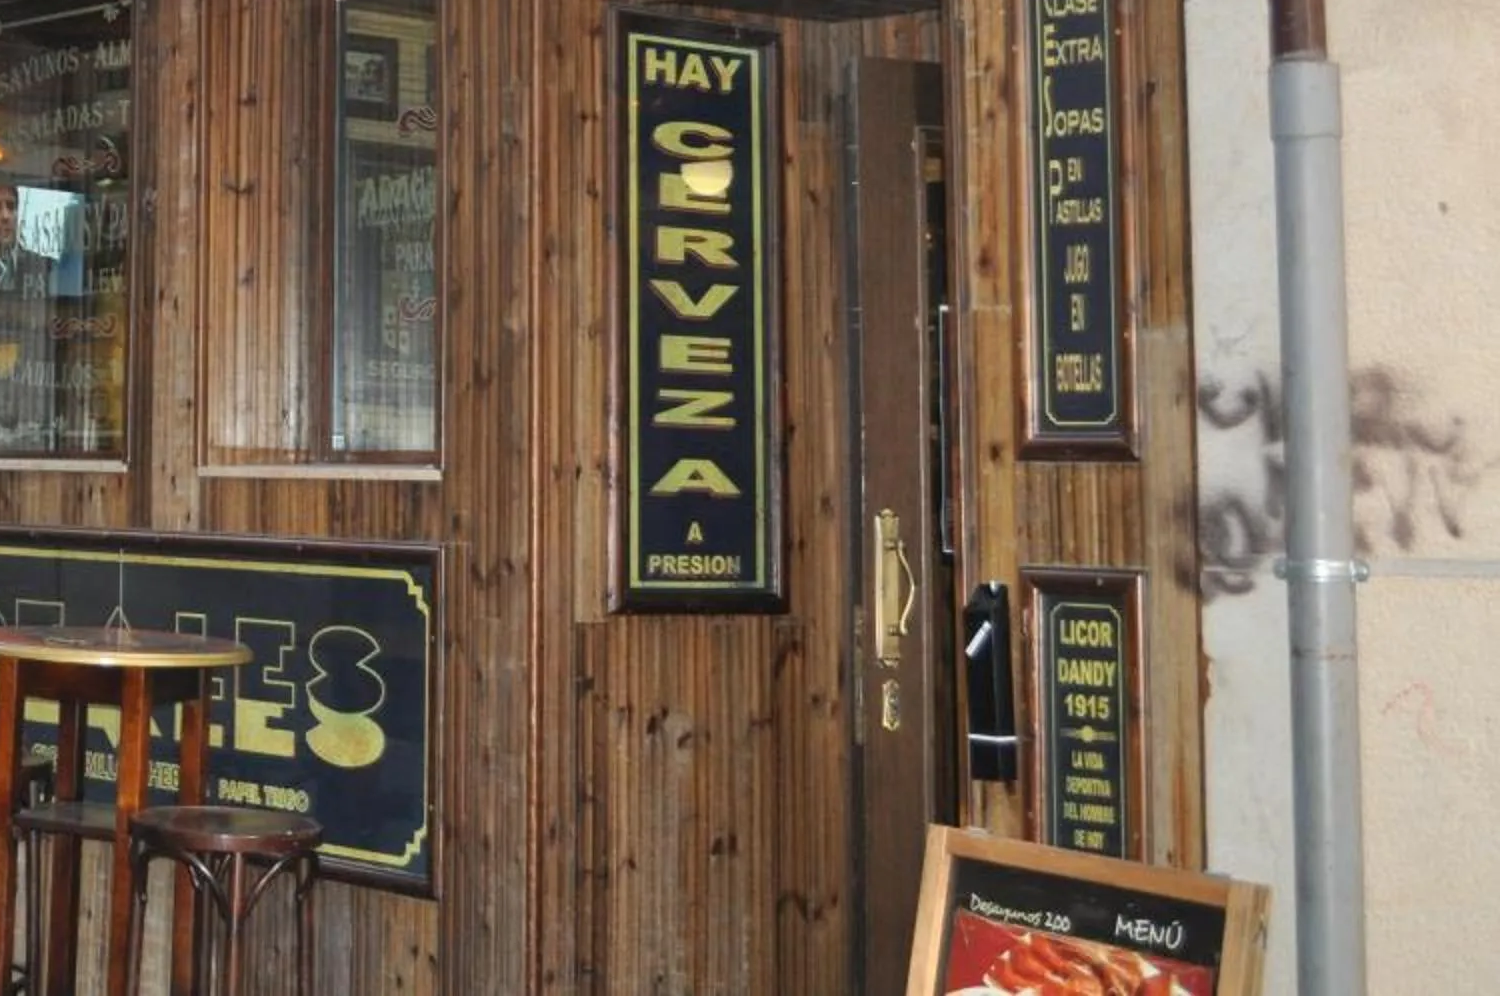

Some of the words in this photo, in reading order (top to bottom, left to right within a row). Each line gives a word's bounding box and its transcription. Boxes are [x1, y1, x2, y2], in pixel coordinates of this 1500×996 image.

[643, 47, 743, 94] HAY
[649, 120, 743, 496] CERVEZA
[686, 520, 704, 543] A
[646, 554, 743, 577] PRESION
[1058, 618, 1113, 648] LICOR
[1056, 657, 1118, 688] DANDY
[1063, 692, 1111, 720] 1915
[1071, 750, 1083, 769] LA
[968, 892, 1043, 927] Desayunos
[1114, 915, 1185, 950] MENÚ
